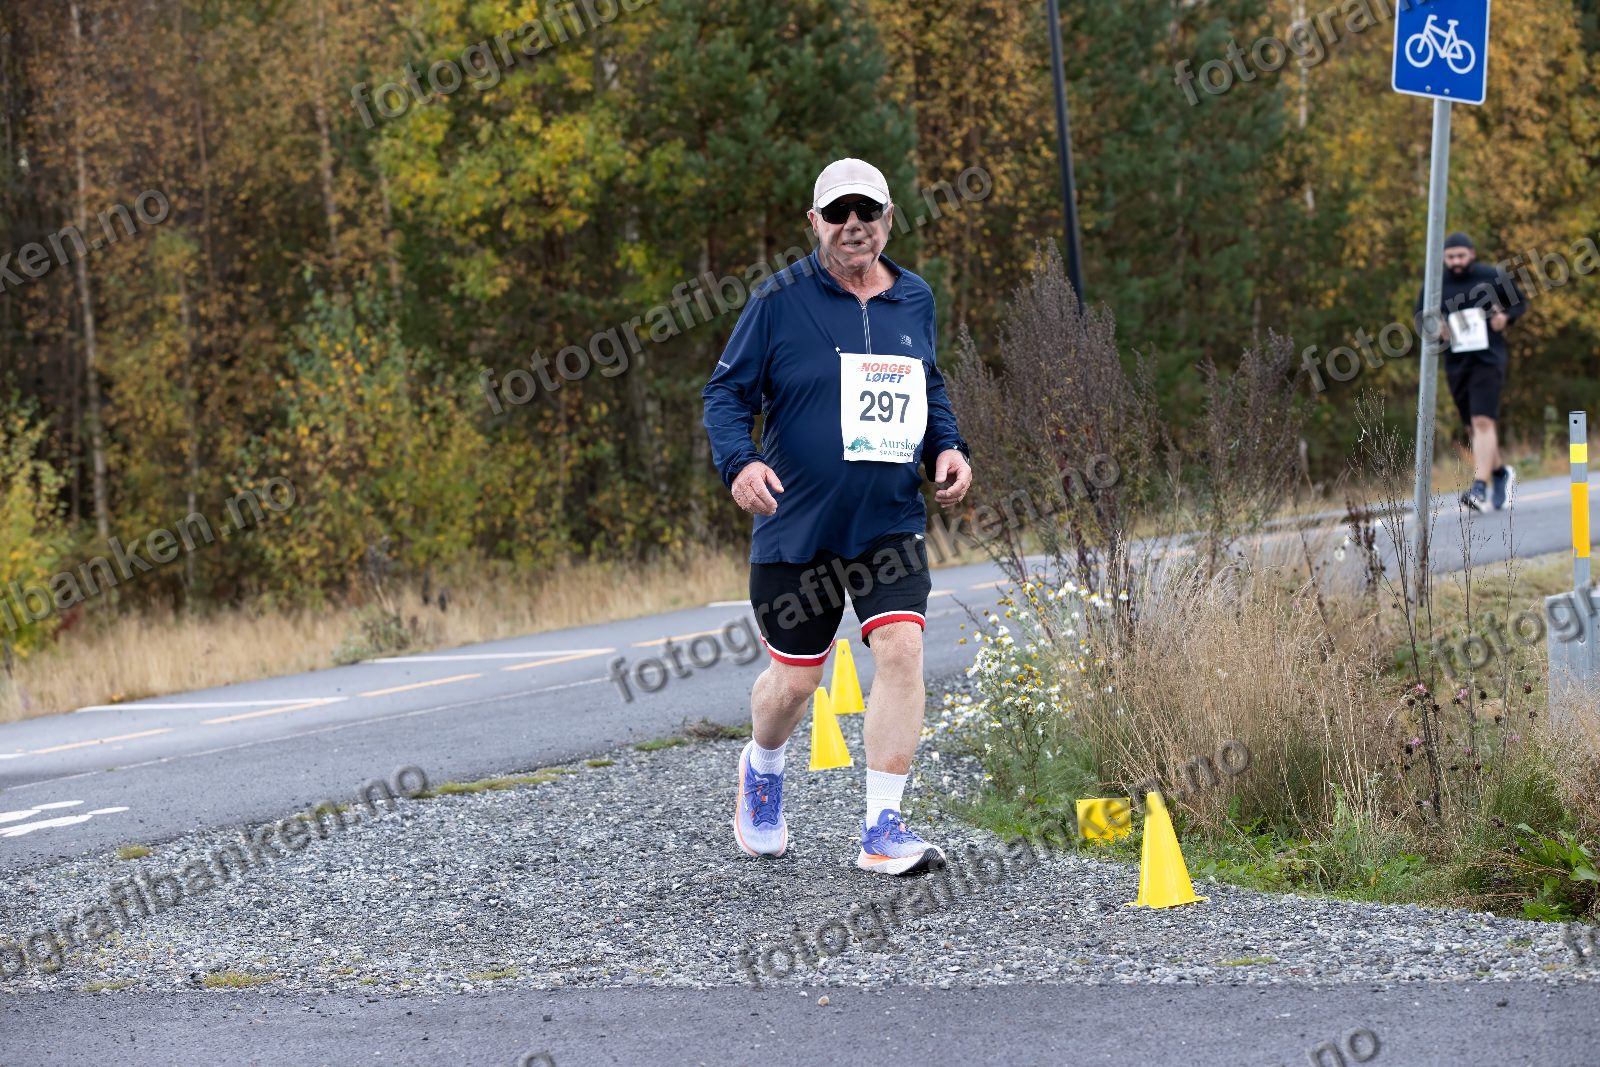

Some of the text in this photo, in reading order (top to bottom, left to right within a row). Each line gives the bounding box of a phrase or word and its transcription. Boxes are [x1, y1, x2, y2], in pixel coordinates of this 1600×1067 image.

[861, 363, 912, 375] NORGES
[866, 373, 905, 384] LØPET
[860, 390, 910, 424] 297
